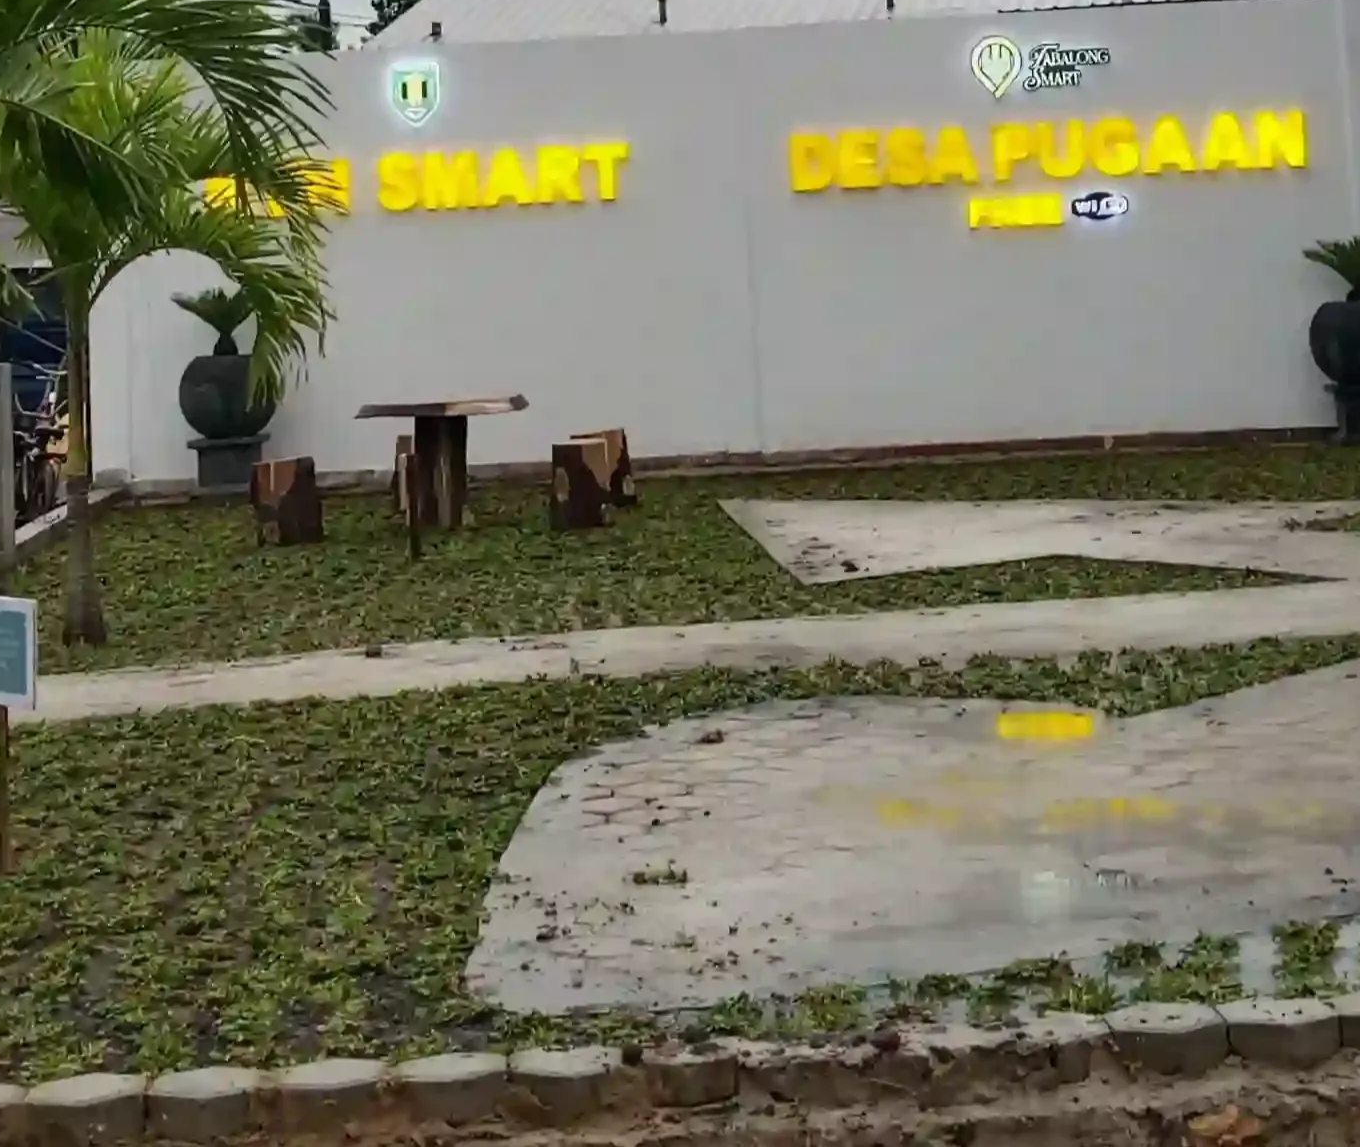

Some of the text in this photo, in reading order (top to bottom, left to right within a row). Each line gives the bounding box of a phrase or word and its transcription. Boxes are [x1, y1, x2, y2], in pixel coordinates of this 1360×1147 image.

[1023, 66, 1082, 92] SMART
[1028, 42, 1110, 70] TABALONG
[789, 109, 1307, 192] DESA PUGAAN
[376, 142, 630, 212] SMART
